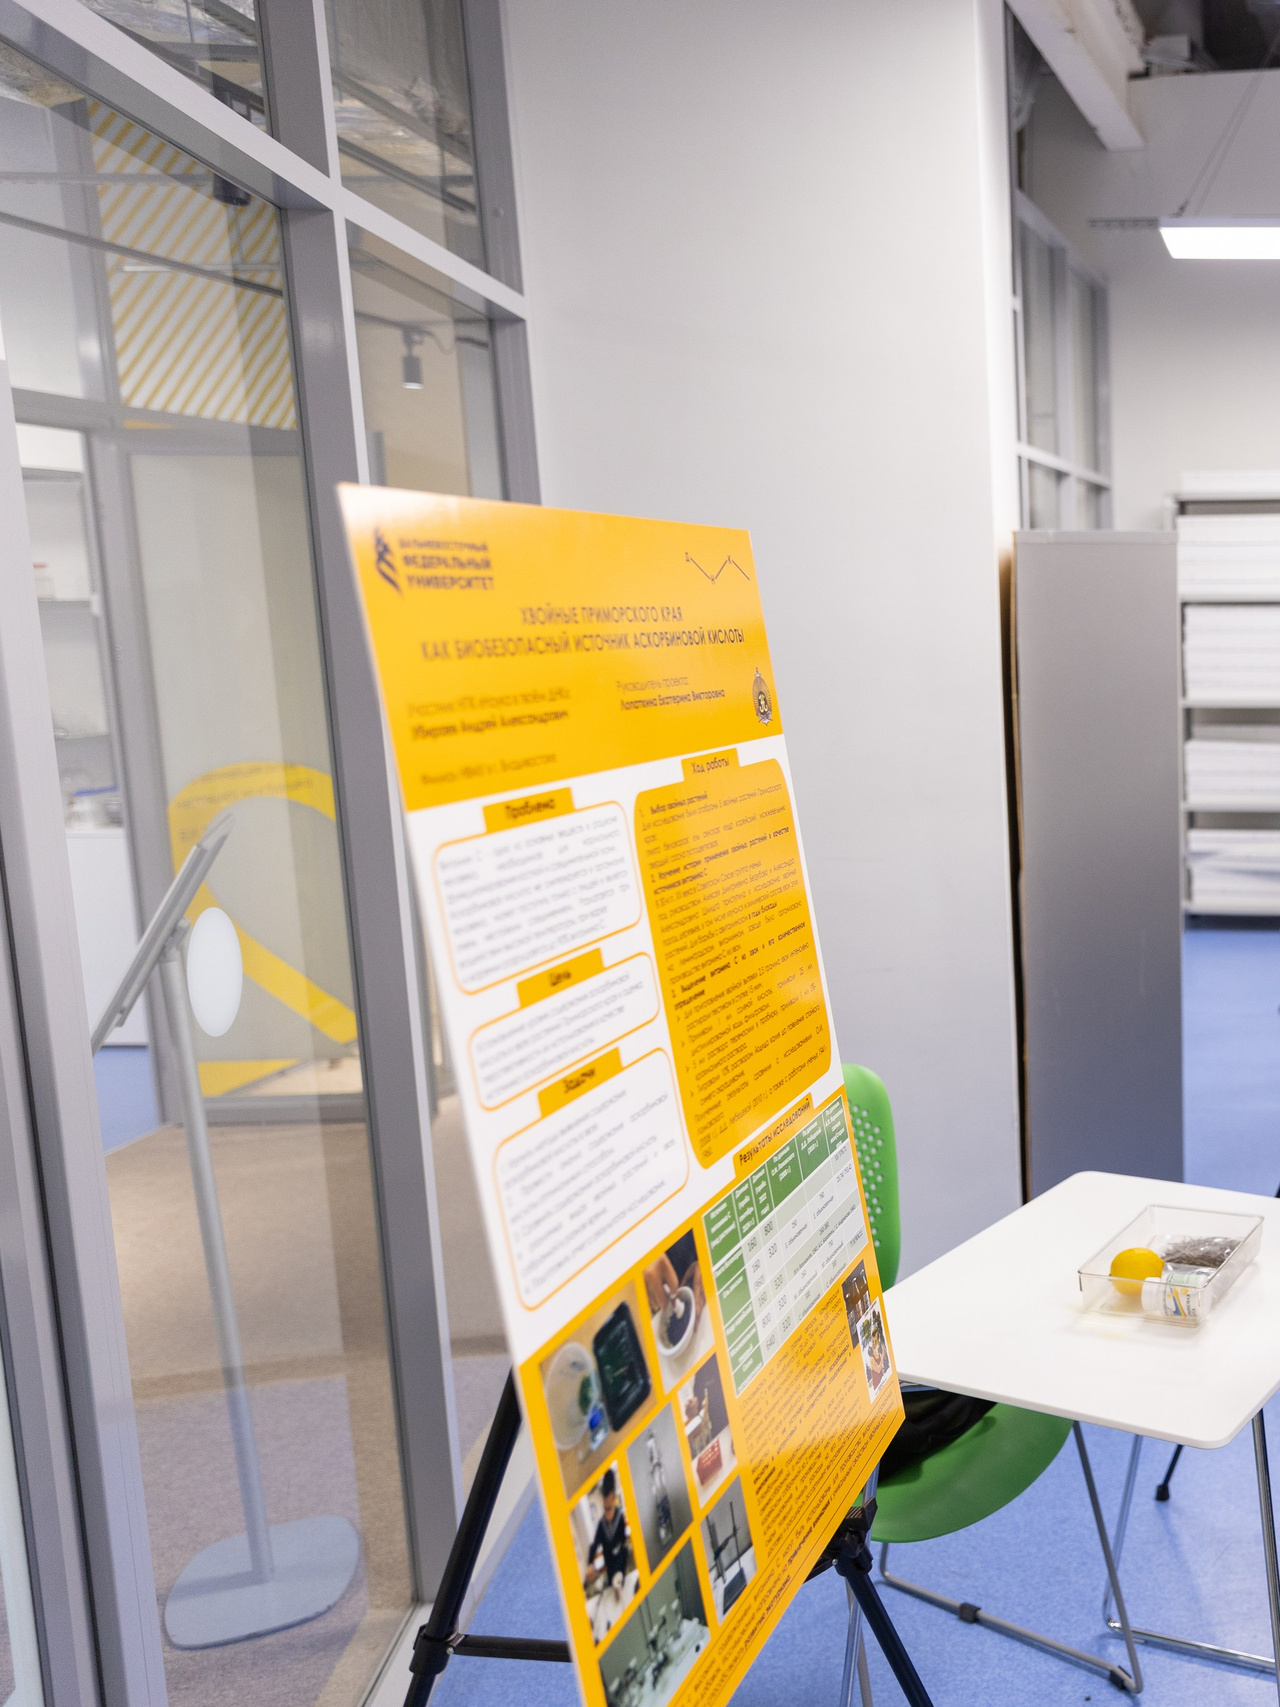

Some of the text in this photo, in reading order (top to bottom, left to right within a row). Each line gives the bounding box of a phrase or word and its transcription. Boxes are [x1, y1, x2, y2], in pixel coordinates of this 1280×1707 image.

[406, 575, 494, 590] УНИВЕРСИТЕТ
[521, 602, 683, 625] ХВОЙНЫЕ ПРИМОРСКОГО КРАЯ
[421, 627, 744, 660] КАК БИОБЕЗОПАСНЫЙ ИСТОЧНИК АСКОРБИНОВОЙ КИСЛОТЫ
[621, 689, 726, 712] Лопаткина Екатерина Викторовна
[691, 757, 730, 774] Ход работы
[505, 797, 556, 820] Проблема
[773, 827, 789, 837] качестве
[760, 899, 777, 914] блокады
[777, 921, 805, 942] количественное
[563, 1067, 596, 1094] Задачи
[738, 1133, 773, 1167] Результаты
[772, 1098, 812, 1138] исследований
